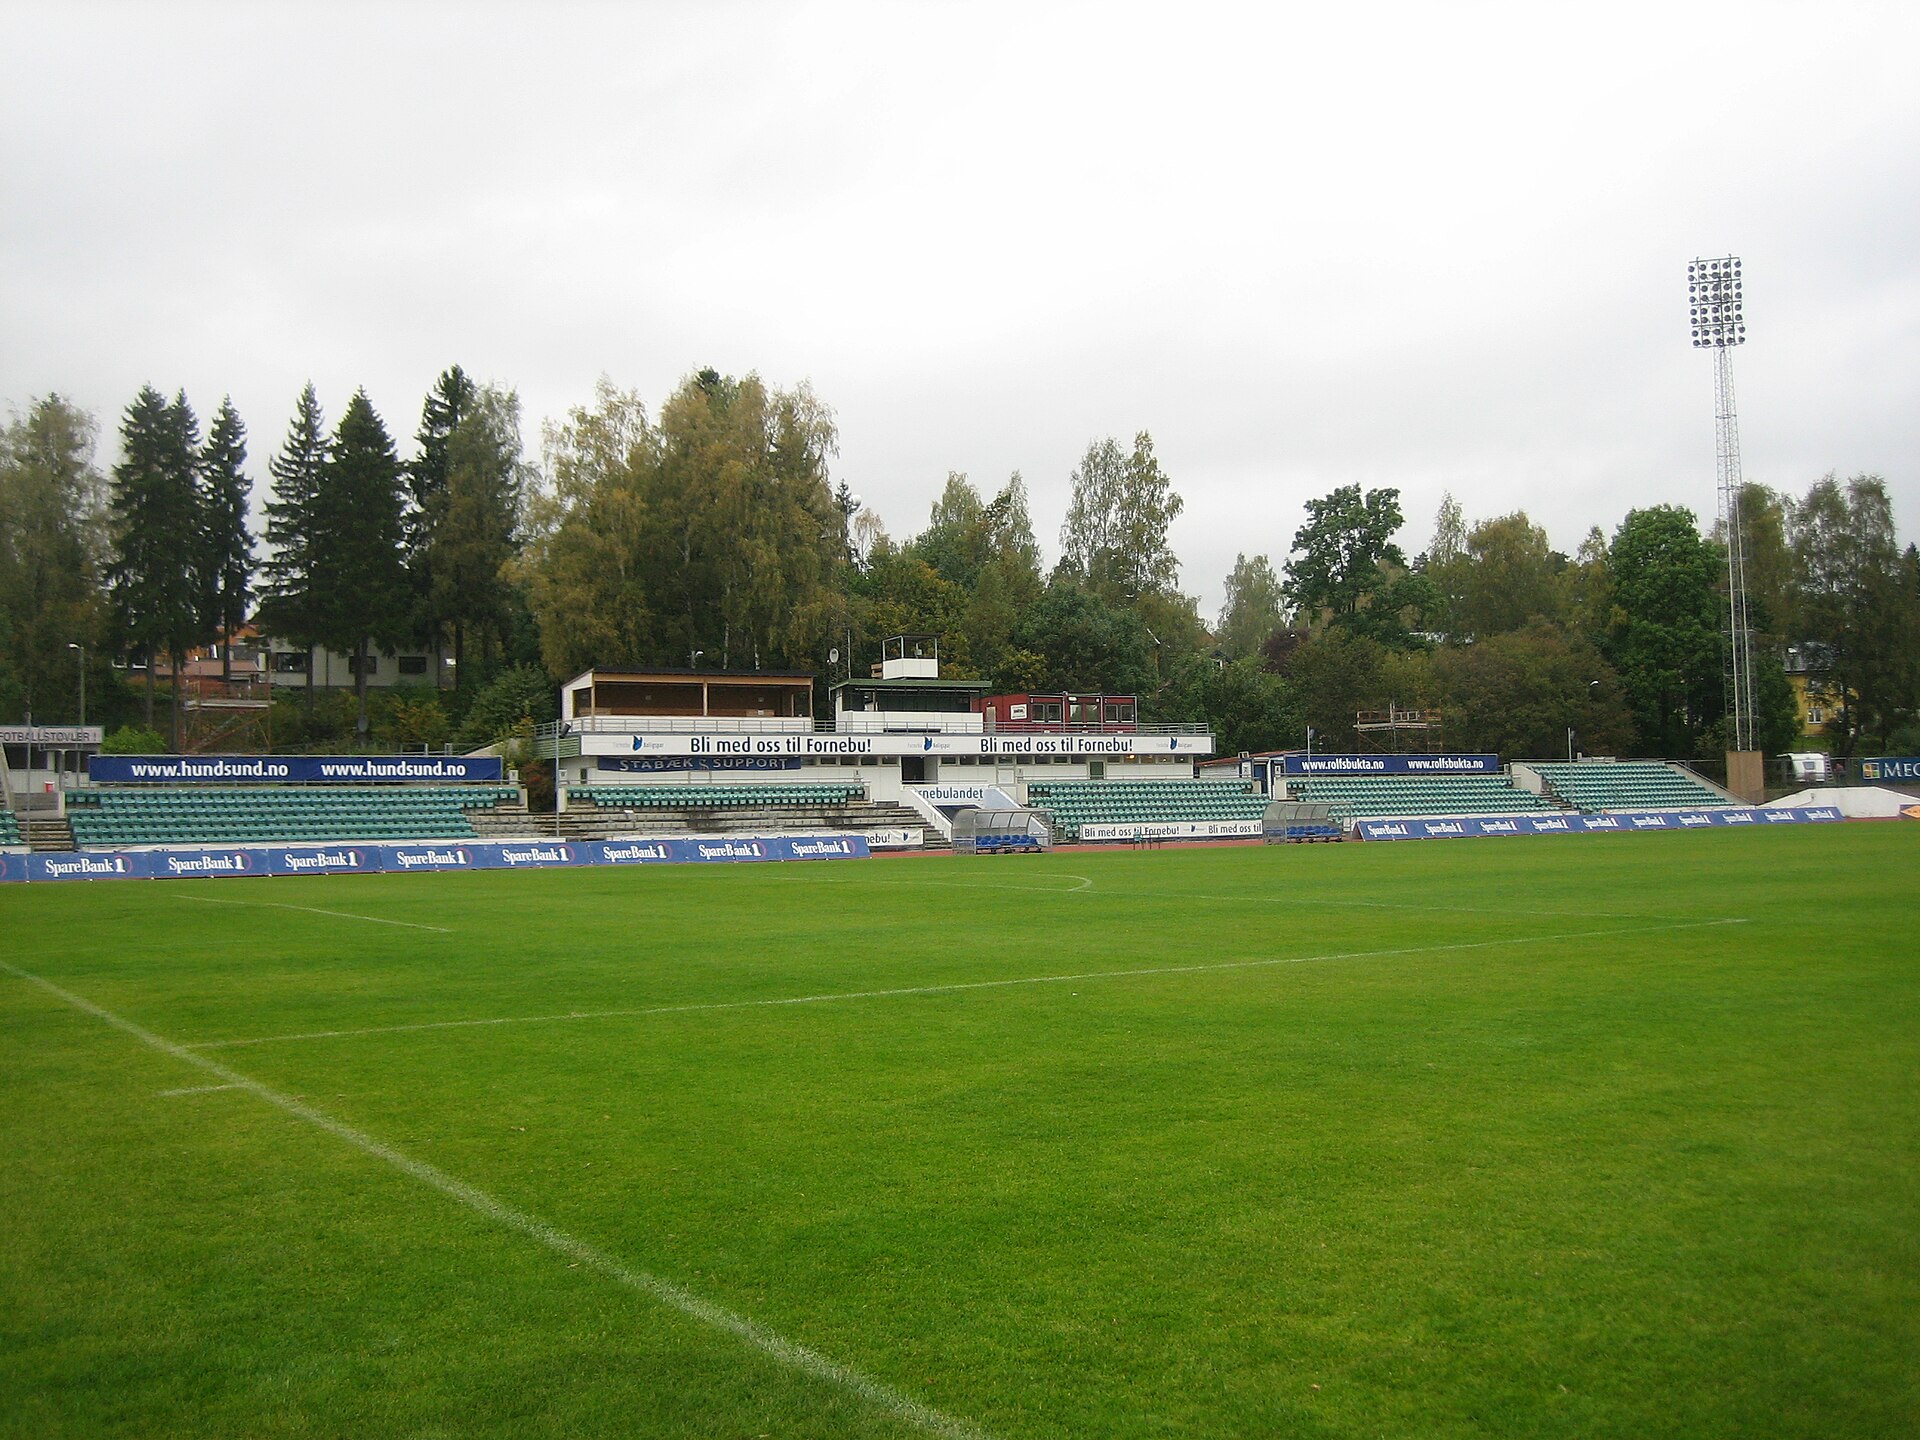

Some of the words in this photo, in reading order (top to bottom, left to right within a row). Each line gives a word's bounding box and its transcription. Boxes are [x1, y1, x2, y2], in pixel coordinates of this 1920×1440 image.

[691, 737, 710, 752] Bli
[717, 737, 750, 752] med
[757, 740, 780, 752] oss
[786, 737, 801, 752] til
[807, 737, 871, 752] Fornebu!
[981, 737, 997, 752] Bli
[1003, 737, 1031, 752] med
[1036, 740, 1056, 752] oss
[1061, 737, 1073, 752] til
[1078, 737, 1133, 752] Fornebu!
[131, 760, 289, 777] www.hundsund.no
[321, 760, 466, 777] www.hundsund.no
[620, 758, 693, 771] STABÆK
[713, 758, 788, 770] SUPPORT
[1302, 758, 1385, 771] www.rolfsbukta.no
[1407, 757, 1484, 770] www.rolfsbukta.no
[1098, 827, 1116, 837] med
[1220, 823, 1238, 833] med
